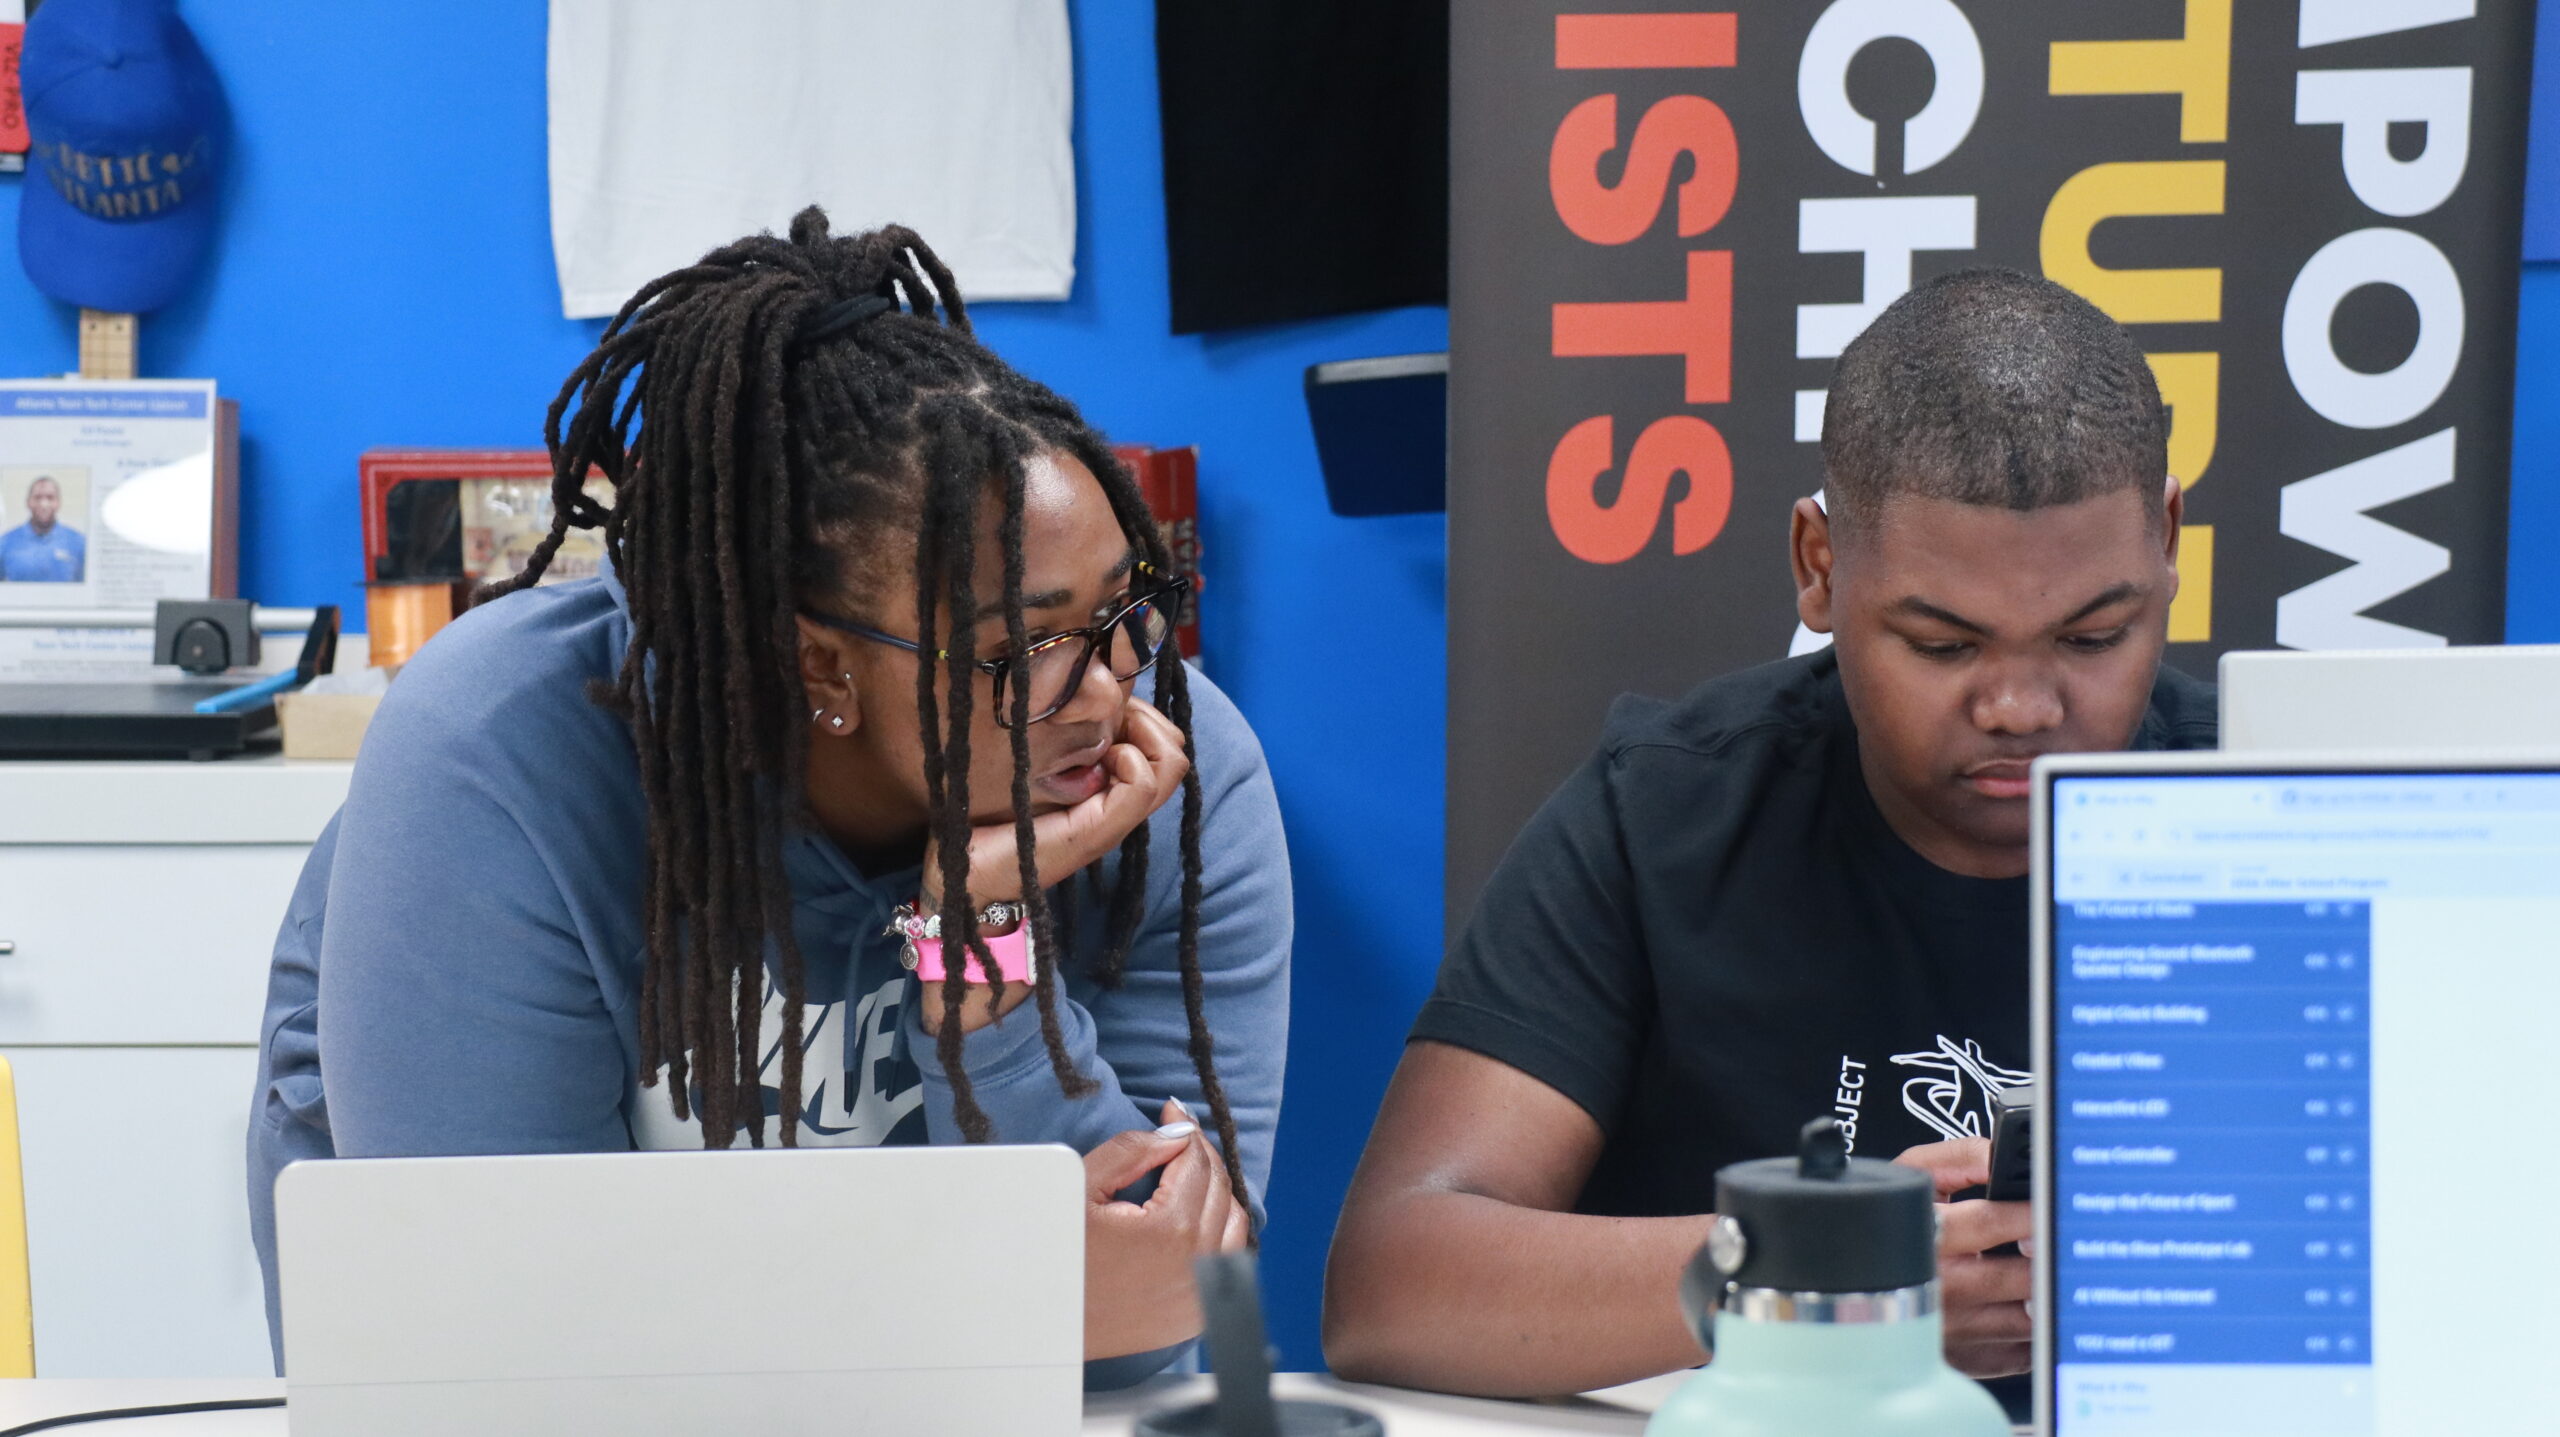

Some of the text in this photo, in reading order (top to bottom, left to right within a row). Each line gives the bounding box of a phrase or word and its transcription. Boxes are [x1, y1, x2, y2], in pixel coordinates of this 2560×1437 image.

[1546, 12, 1739, 564] ISTS
[2038, 0, 2231, 642] TU
[2276, 0, 2476, 651] POW
[1833, 1055, 1866, 1165] BJECT
